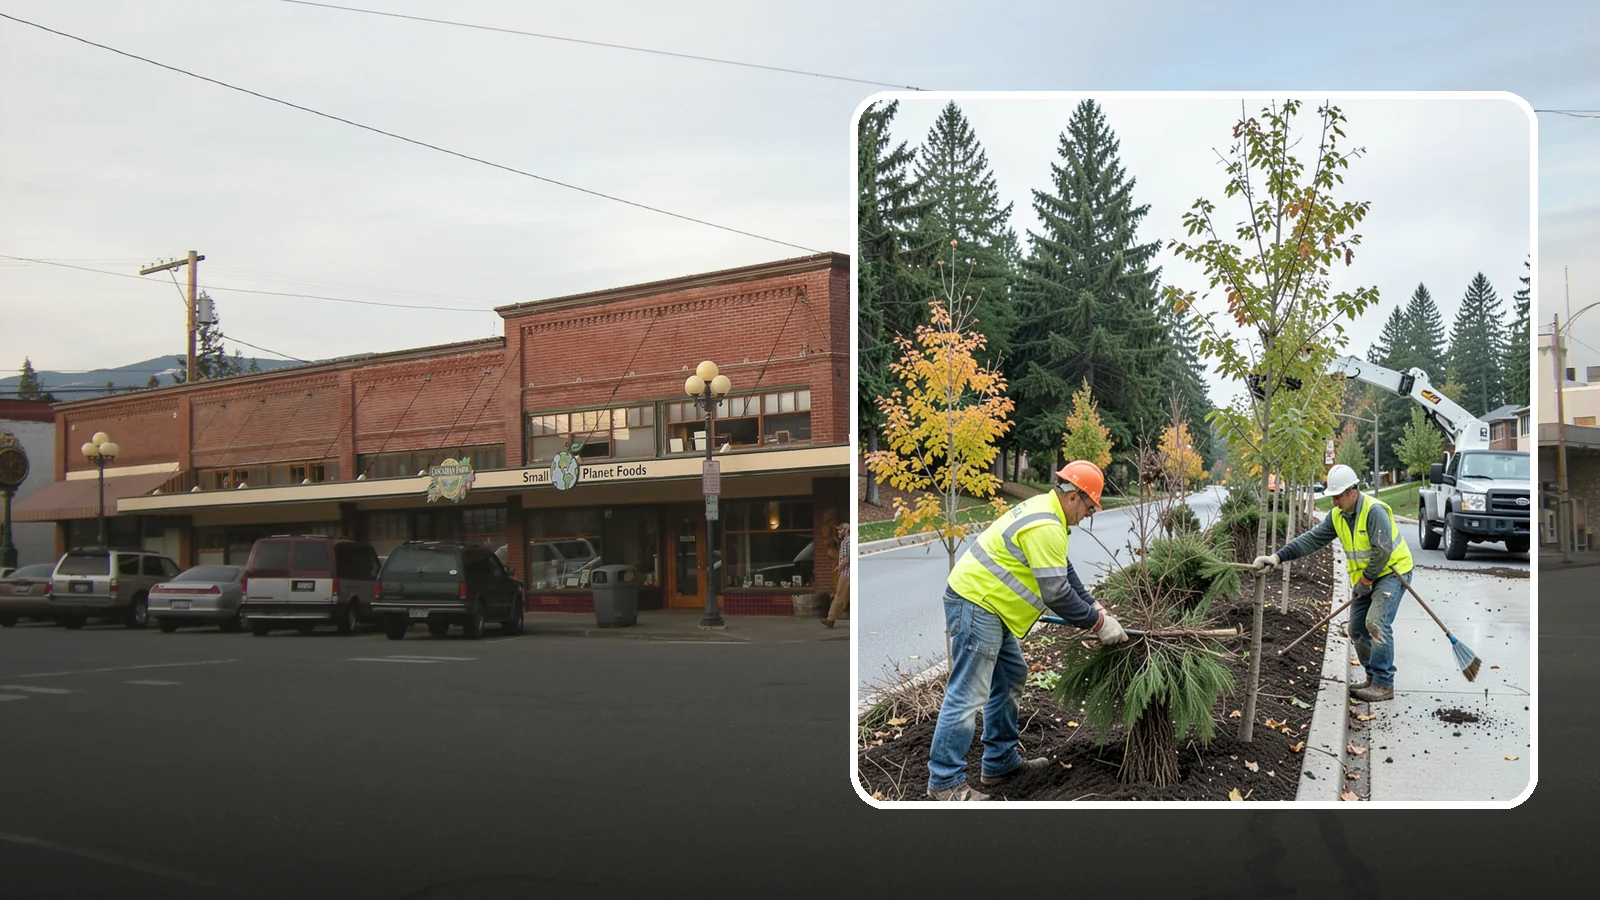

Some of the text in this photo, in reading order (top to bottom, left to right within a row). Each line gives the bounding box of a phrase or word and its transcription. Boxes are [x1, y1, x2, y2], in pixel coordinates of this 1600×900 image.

[523, 465, 647, 483] Small Planet Foods
